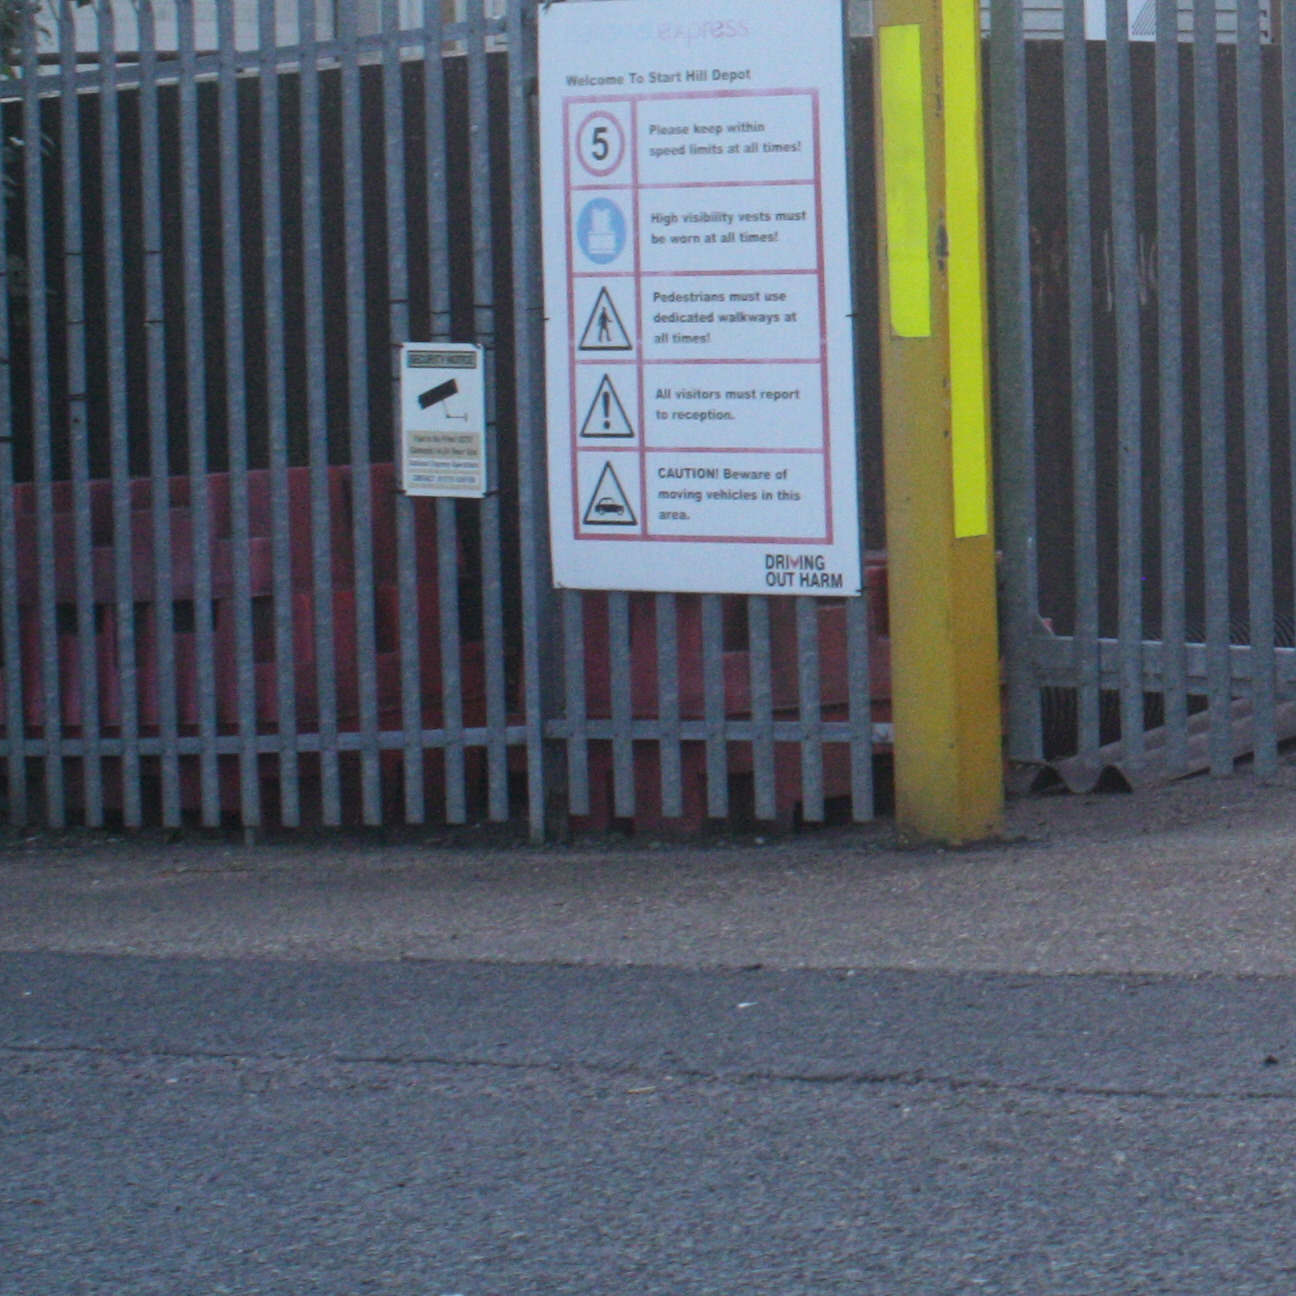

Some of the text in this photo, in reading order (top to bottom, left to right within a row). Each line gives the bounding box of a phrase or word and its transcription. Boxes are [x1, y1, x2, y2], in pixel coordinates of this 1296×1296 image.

[658, 19, 749, 43] express
[566, 69, 751, 86] Welcome To Start Hill Depot
[649, 122, 765, 136] Please keep within
[592, 126, 609, 160] 5
[649, 141, 801, 156] speed limits at all times!
[652, 210, 806, 226] High visibility vests must
[652, 231, 778, 244] be worn at all times!
[653, 292, 787, 302] Pedestrians must use
[654, 312, 797, 325] dedicated walkways at
[654, 333, 710, 344] all times!
[656, 389, 800, 401] All visitors must report
[656, 409, 734, 422] to reception.
[658, 468, 788, 479] CAUTION! Beware of
[659, 490, 800, 502] moving vehicles in this
[659, 510, 690, 520] area.
[766, 572, 842, 588] OUT HARM
